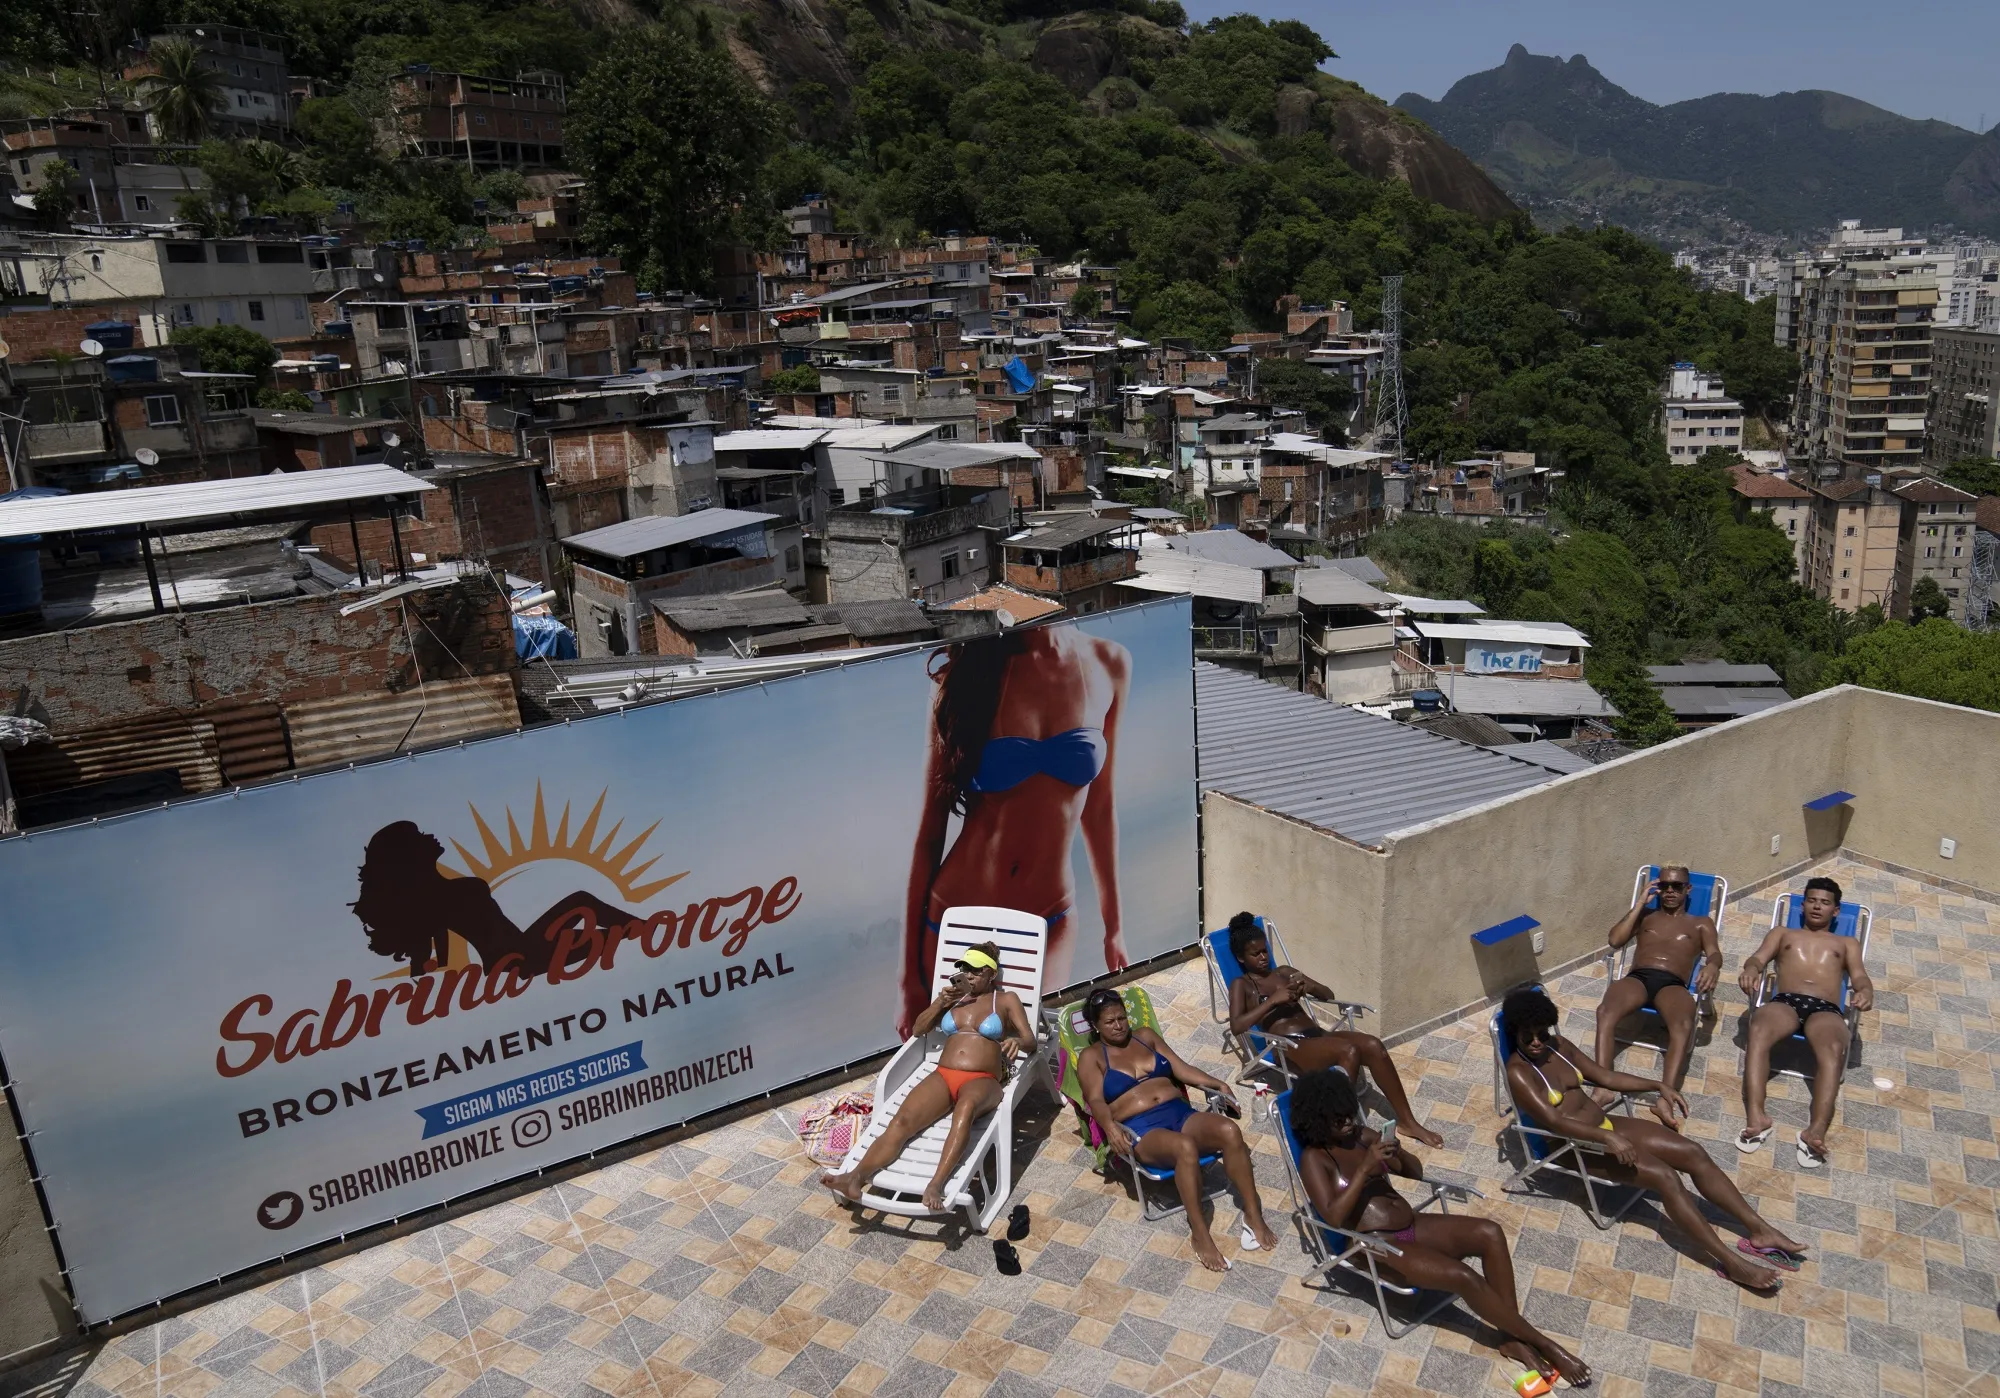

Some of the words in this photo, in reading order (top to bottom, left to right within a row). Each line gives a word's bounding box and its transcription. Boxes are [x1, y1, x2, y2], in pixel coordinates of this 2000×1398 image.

[736, 530, 763, 543] ESTUDAR
[745, 540, 765, 552] 2017
[1481, 651, 1514, 668] The
[216, 952, 535, 1077] Sabrina
[545, 875, 802, 985] Bronze
[238, 1008, 608, 1138] BRONZEAMENTO
[623, 952, 796, 1023] NATURAL
[444, 1093, 494, 1125] SIGAM
[496, 1084, 527, 1108] NAS
[530, 1069, 575, 1098] REDES
[579, 1051, 631, 1083] SOCIAS
[308, 1126, 505, 1212] SABRINABRONZE
[558, 1045, 754, 1131] SABRINABRONZECH
